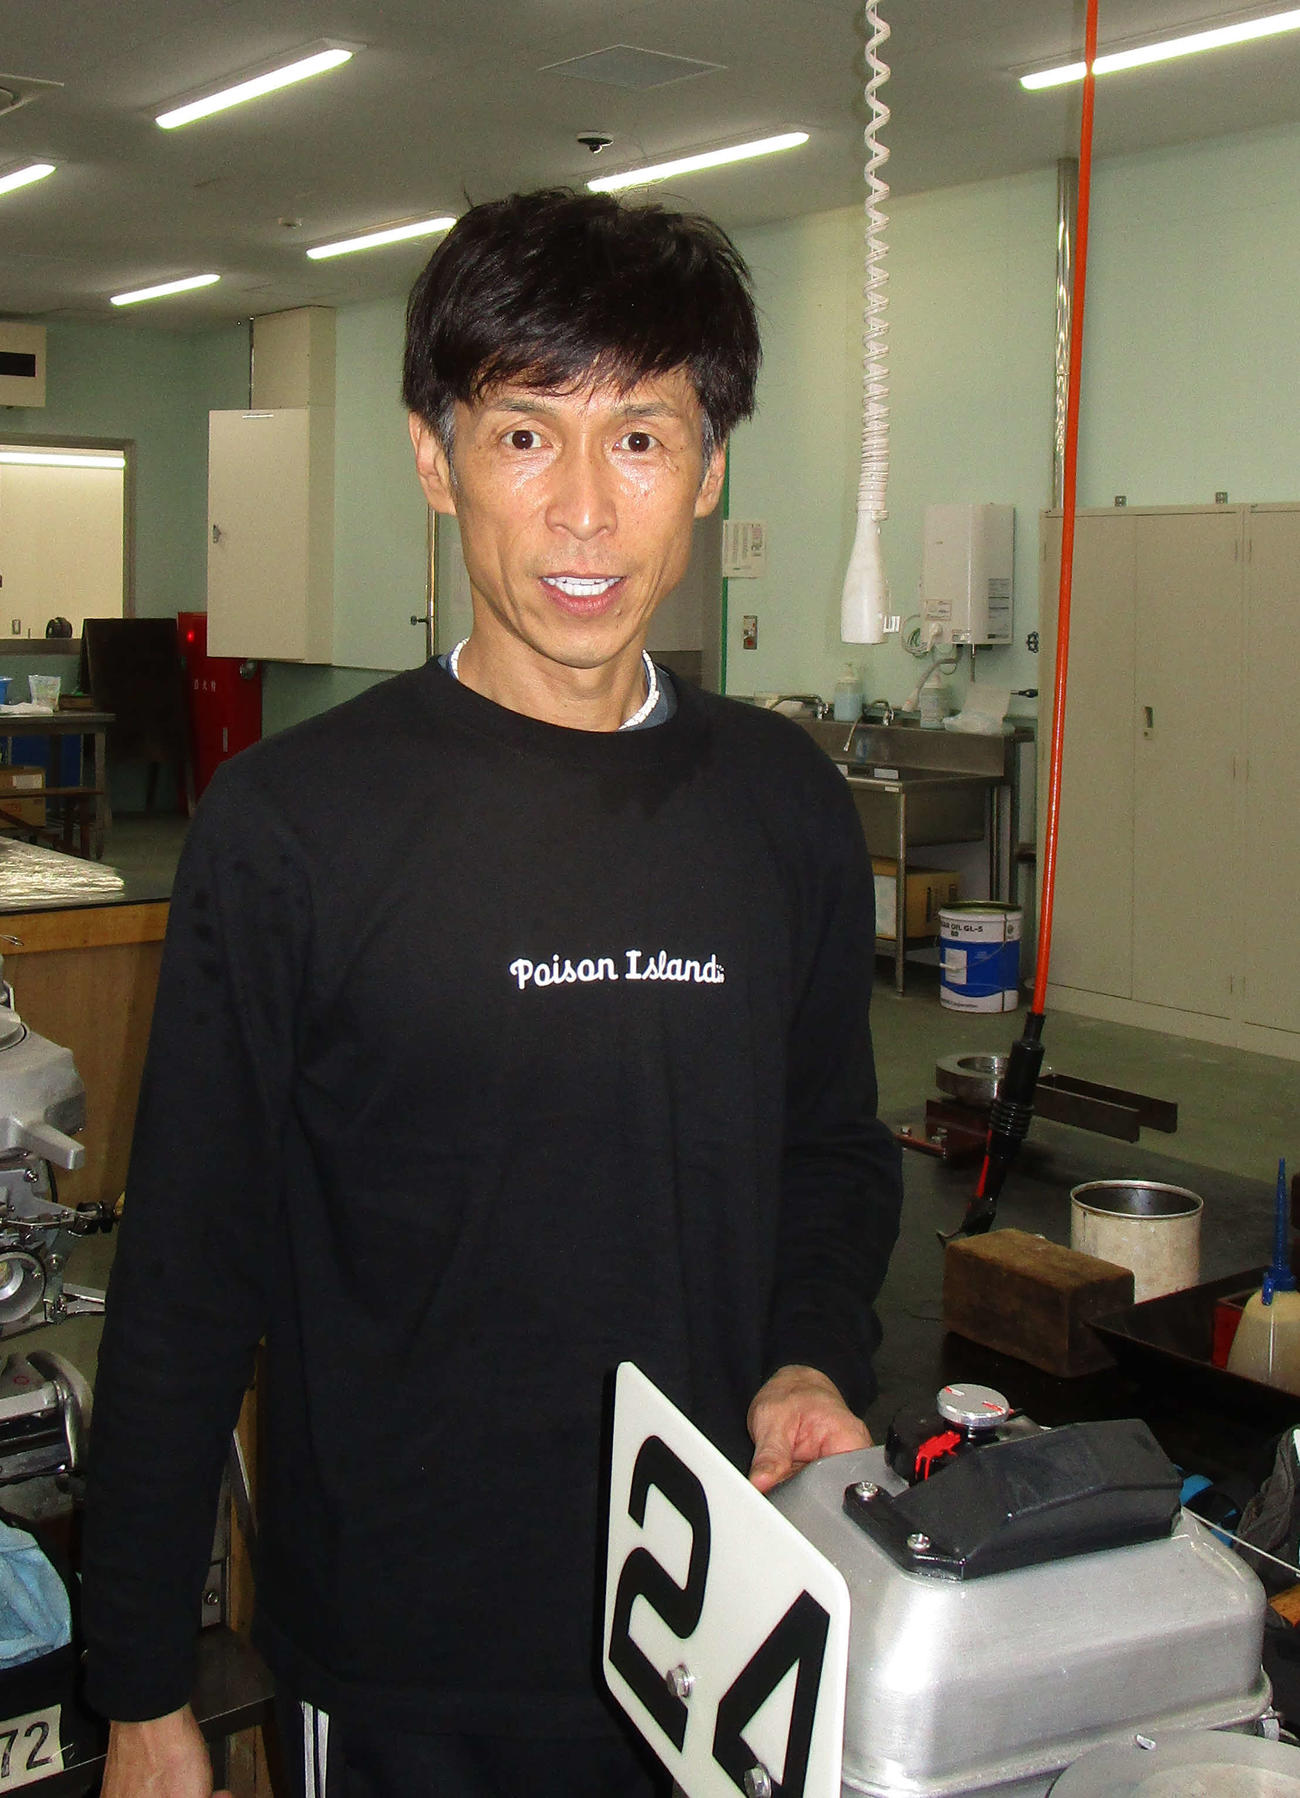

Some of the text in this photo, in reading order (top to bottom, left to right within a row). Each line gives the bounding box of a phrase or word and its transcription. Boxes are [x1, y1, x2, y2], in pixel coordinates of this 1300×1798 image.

[509, 949, 720, 990] Poison Island
[608, 1434, 831, 1798] 24
